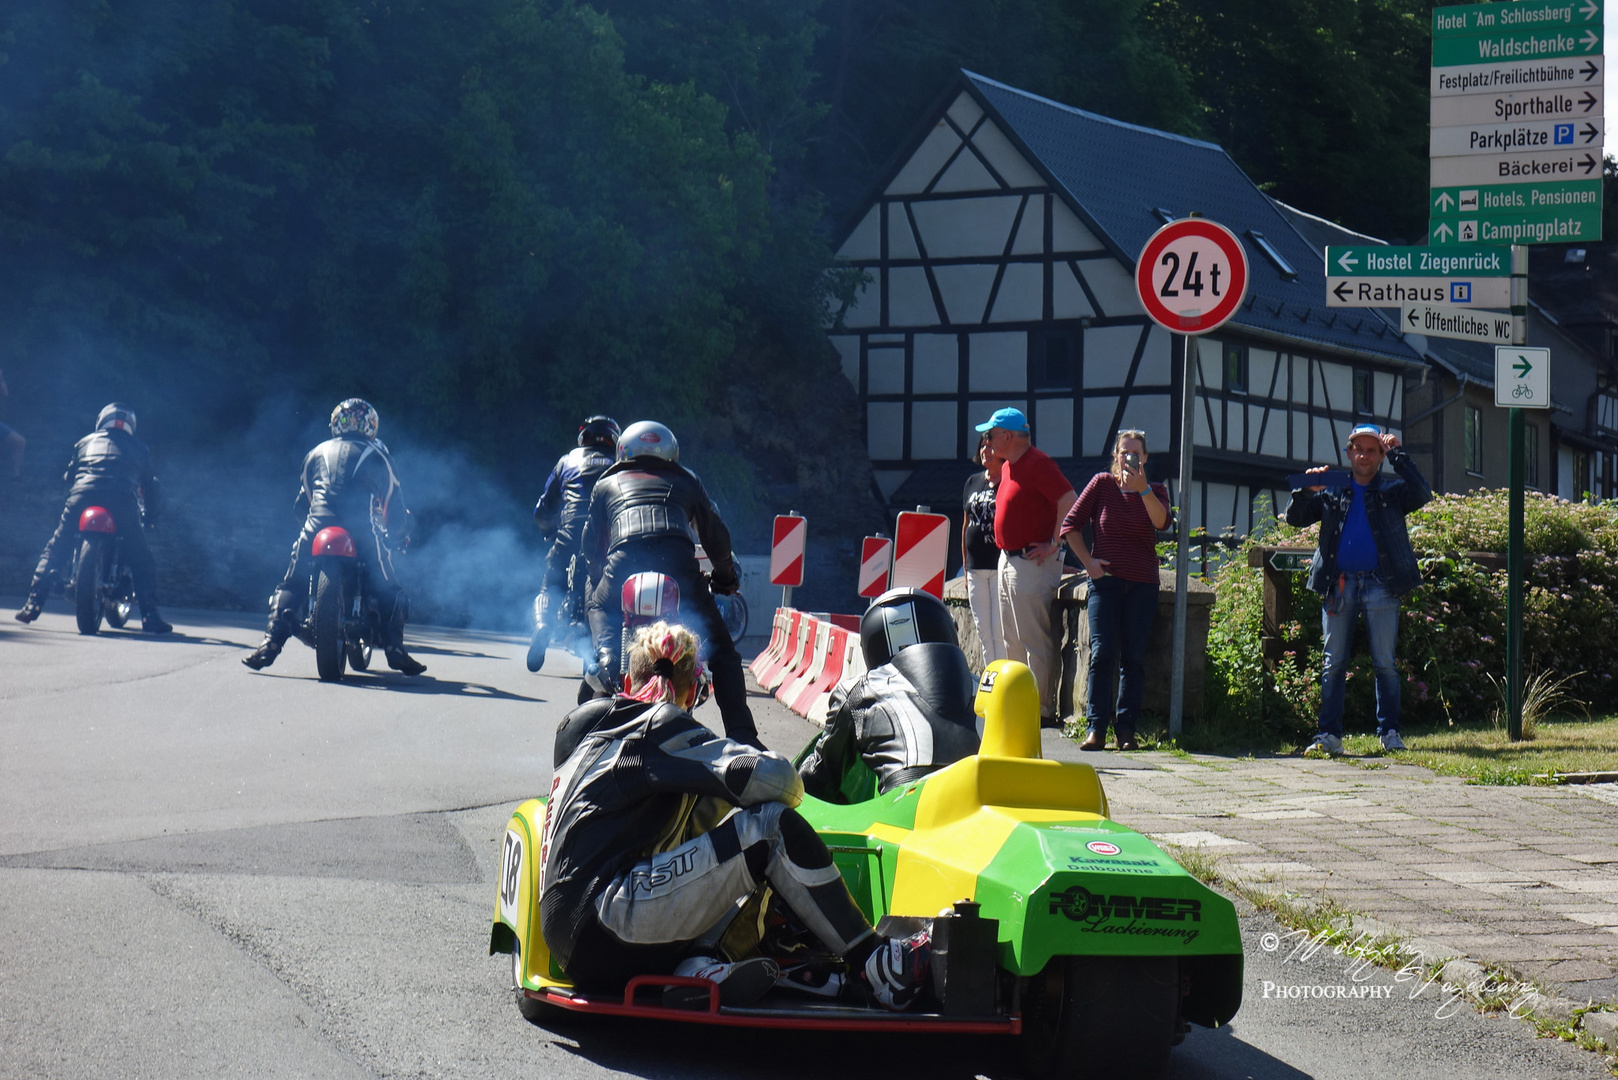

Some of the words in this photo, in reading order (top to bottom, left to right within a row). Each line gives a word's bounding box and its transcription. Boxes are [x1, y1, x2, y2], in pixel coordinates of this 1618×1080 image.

[1437, 13, 1467, 30] Hotel
[1478, 34, 1575, 58] Waldschenke
[1439, 66, 1574, 92] Festplatz/Freilichtbühne
[1495, 95, 1573, 121] Sporthalle
[1470, 128, 1548, 151] Parkplätze
[1558, 126, 1570, 143] P
[1499, 158, 1573, 177] Bäckerei
[1484, 190, 1526, 208] Hotels,
[1531, 188, 1596, 206] Pensionen
[1482, 217, 1582, 243] Campingplatz
[1367, 253, 1412, 270] Hostel
[1419, 252, 1500, 275] Ziegenrück
[1358, 282, 1445, 301] Rathaus
[1424, 307, 1489, 337] Öffentliches
[1494, 319, 1511, 340] WC
[501, 831, 522, 909] 18
[1069, 855, 1160, 867] Kawasaki
[1081, 915, 1200, 945] Lackierung
